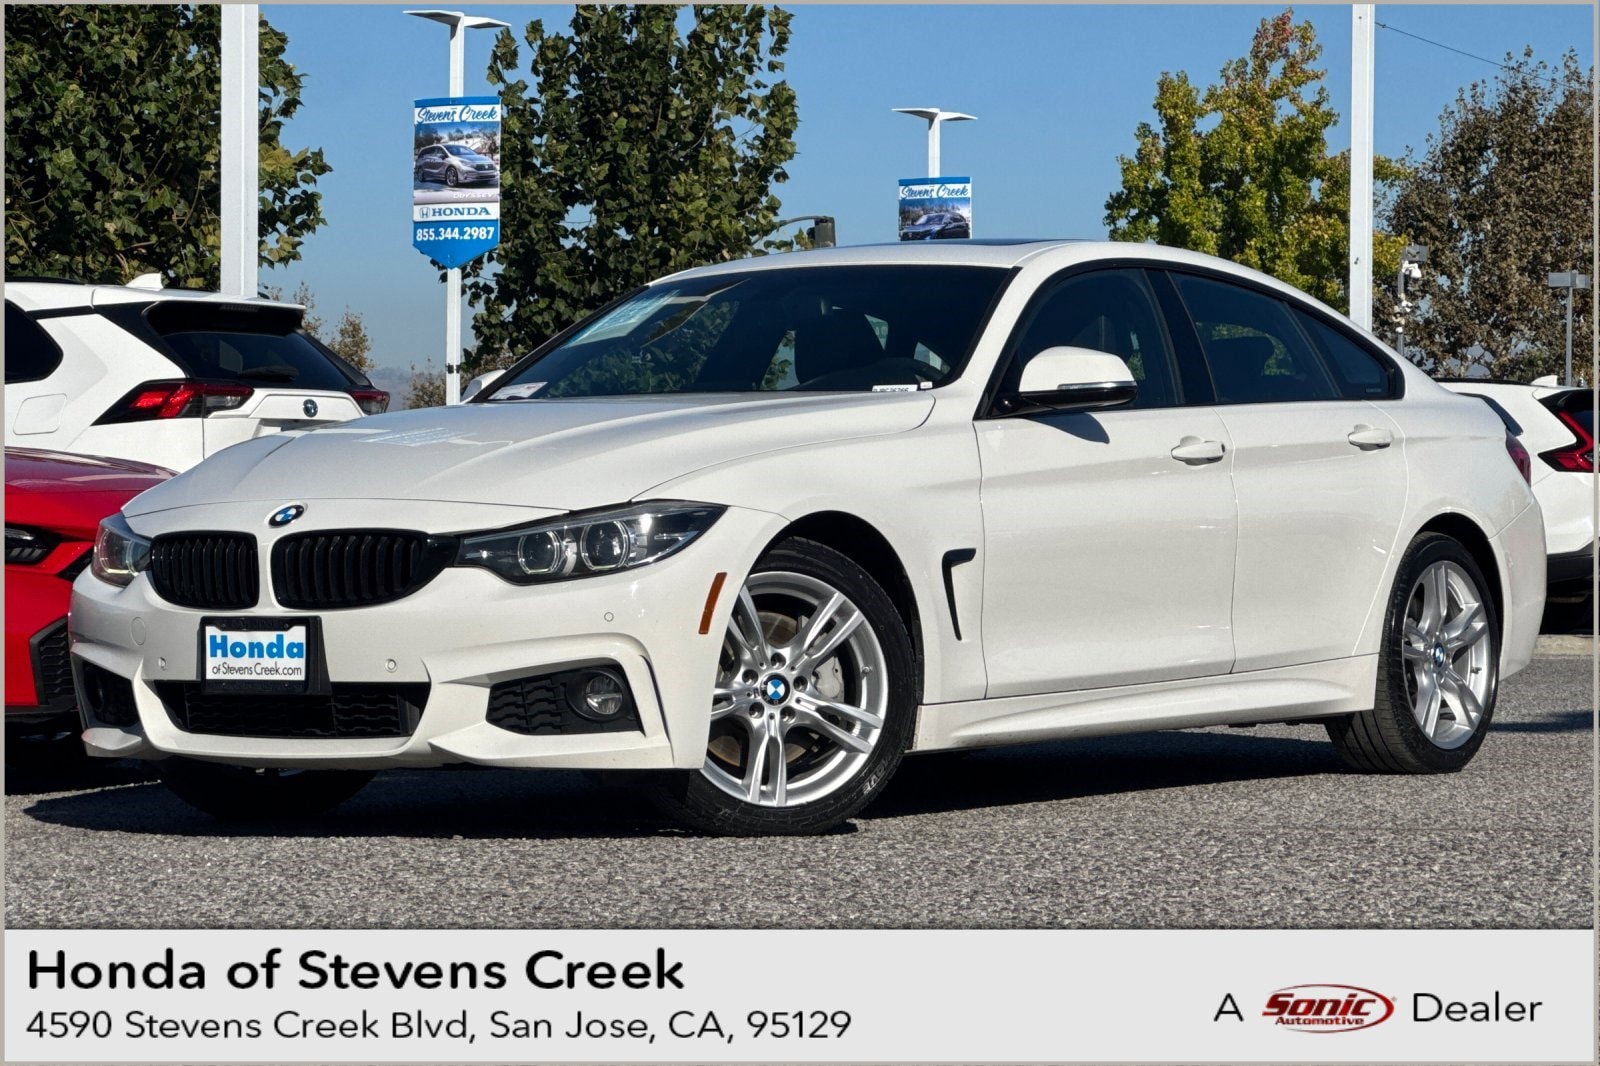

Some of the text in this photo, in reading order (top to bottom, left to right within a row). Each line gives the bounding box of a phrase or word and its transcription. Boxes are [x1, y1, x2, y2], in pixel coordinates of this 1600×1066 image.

[417, 105, 497, 124] Stevens Creek
[901, 184, 968, 200] Stevens Creek
[432, 207, 491, 217] HONDA
[416, 227, 495, 242] 855.344.2987
[209, 633, 305, 659] Honda
[212, 661, 302, 676] of Stevens Creek.com
